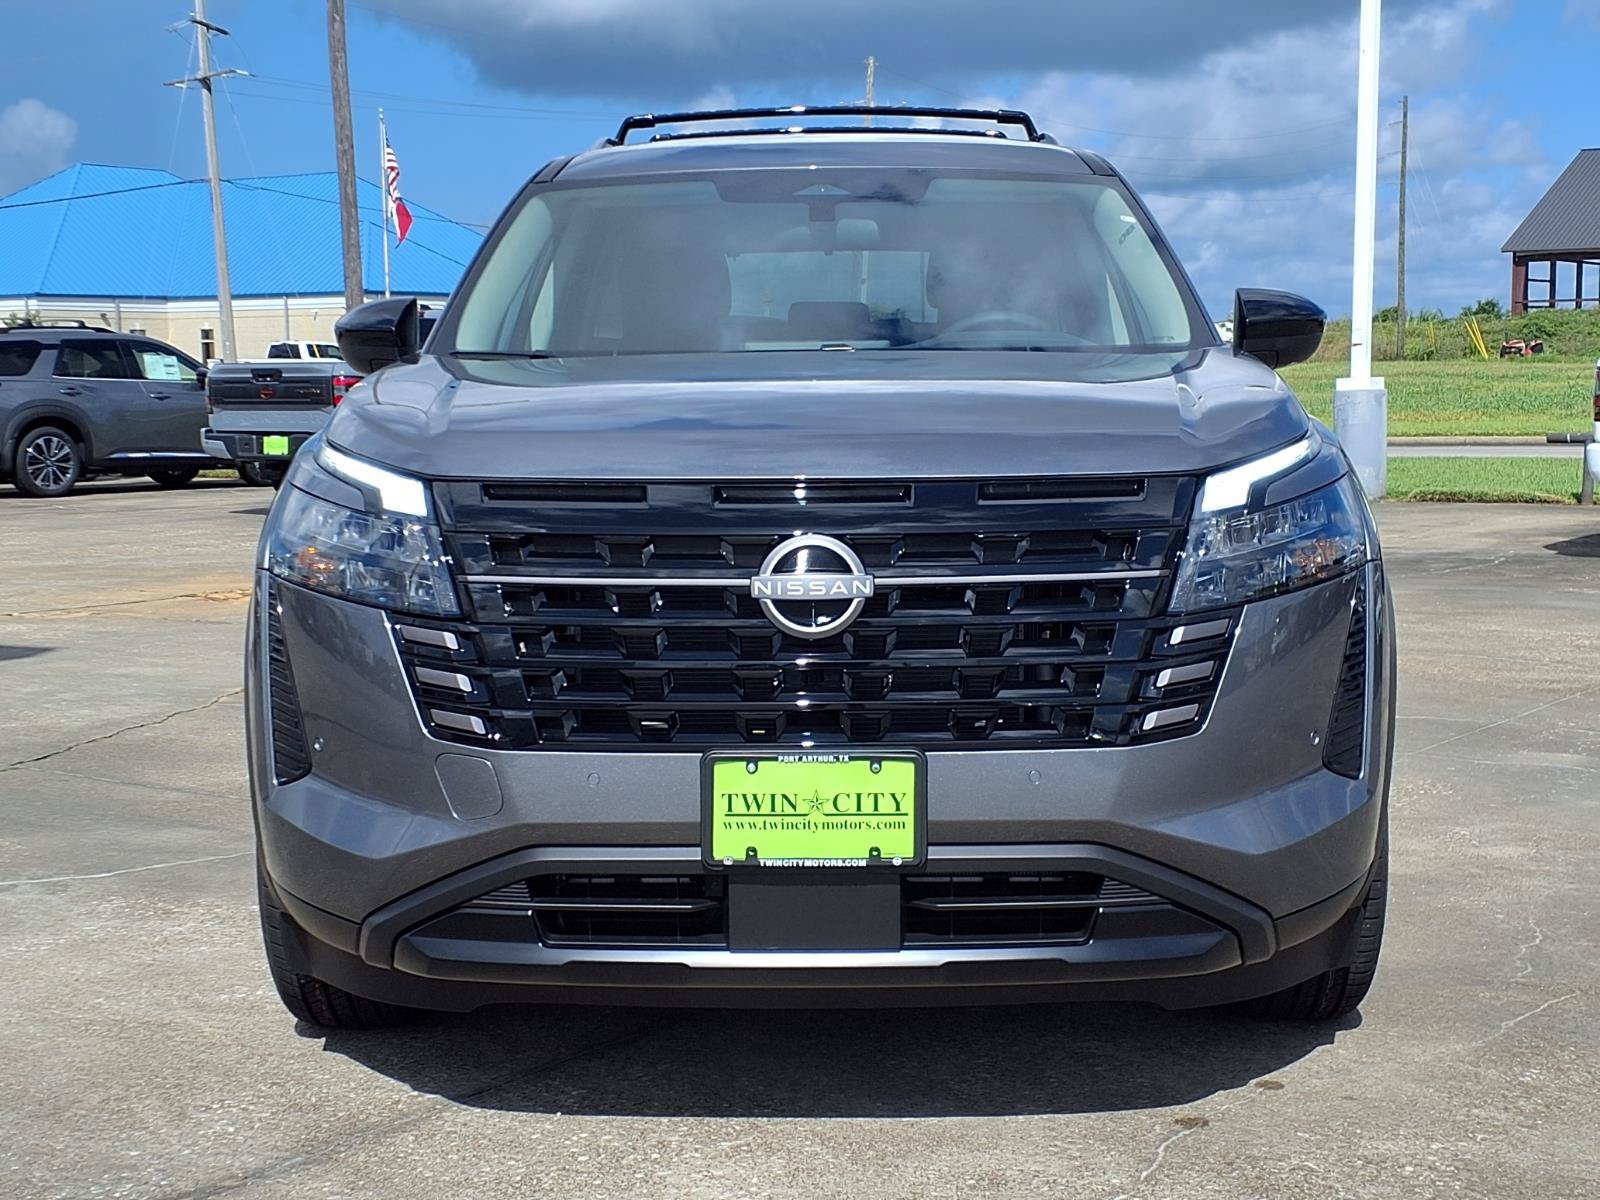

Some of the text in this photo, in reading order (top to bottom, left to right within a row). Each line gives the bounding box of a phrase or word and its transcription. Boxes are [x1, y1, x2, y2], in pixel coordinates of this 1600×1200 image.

[754, 580, 871, 596] NISSAN
[778, 755, 799, 763] PORT
[839, 755, 849, 763] TX
[722, 793, 907, 813] TWIN CITY
[723, 818, 906, 834] www.twincitymotors.com
[759, 859, 867, 867] TWINCITYMOTORS.COM
